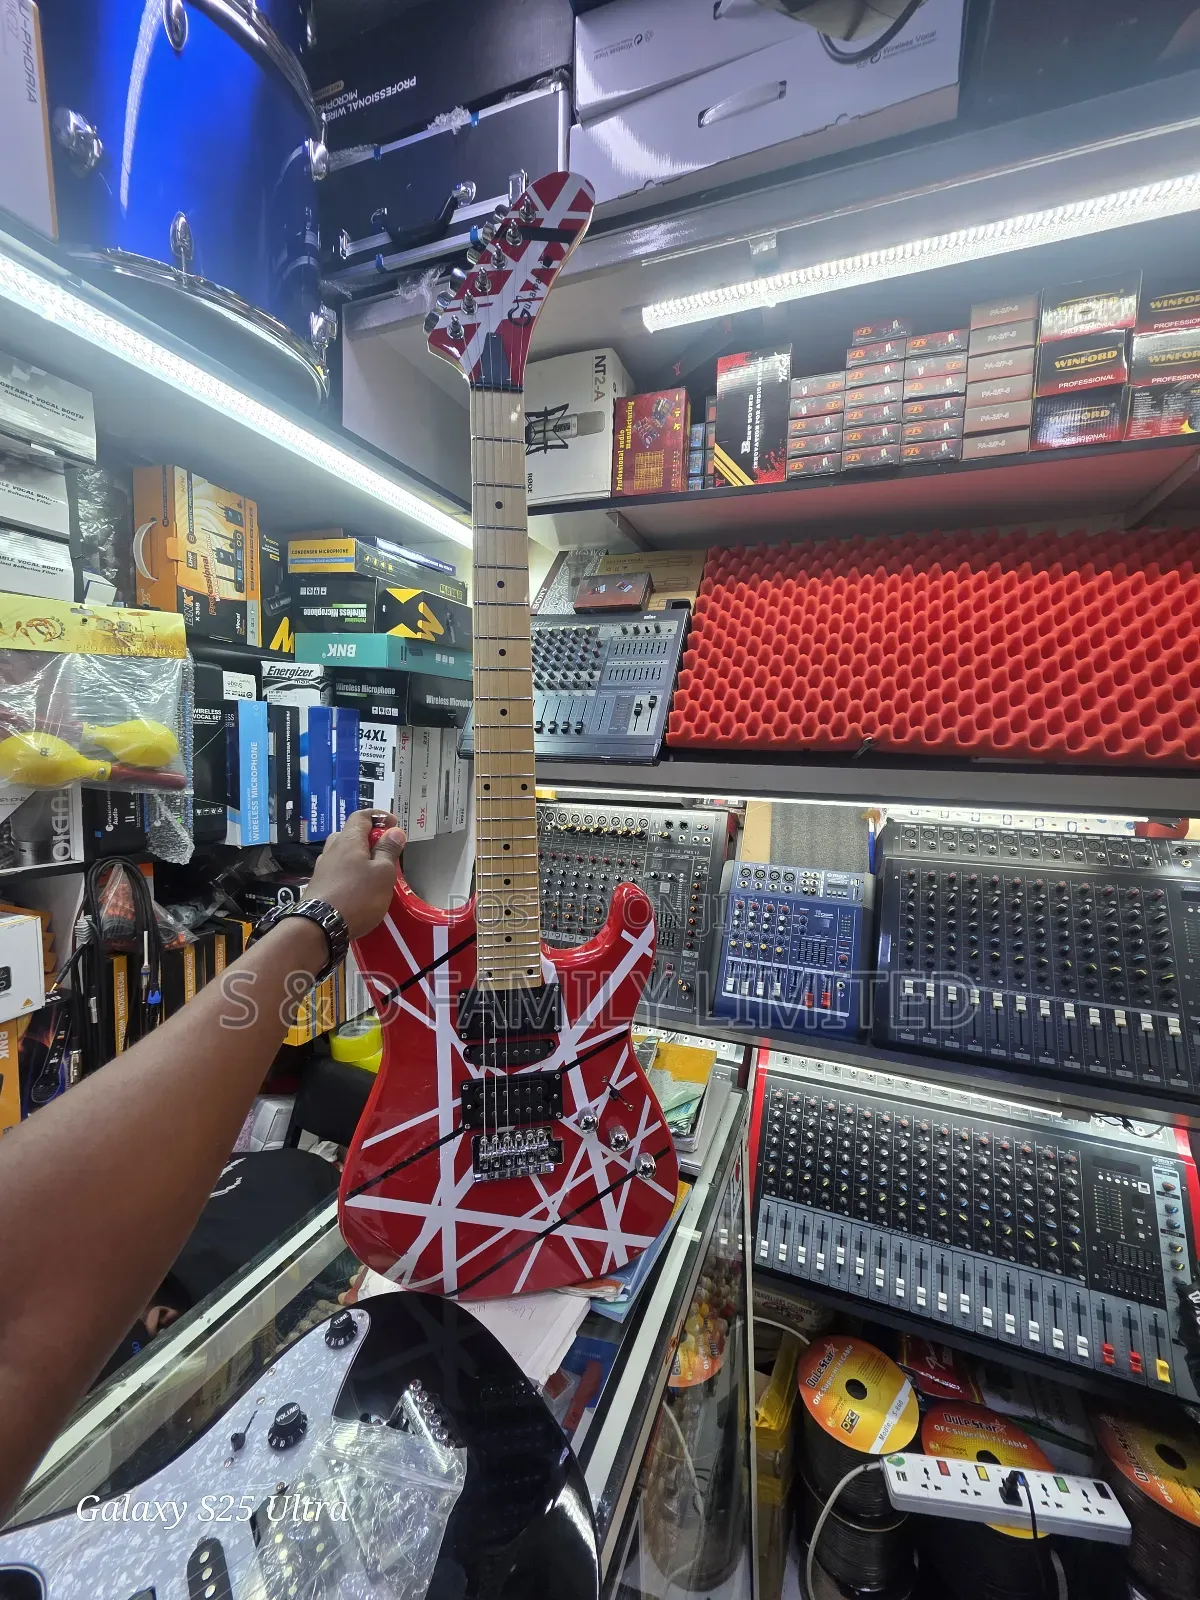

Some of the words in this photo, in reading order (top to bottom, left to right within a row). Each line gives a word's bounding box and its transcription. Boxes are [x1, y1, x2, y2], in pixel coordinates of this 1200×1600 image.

[349, 76, 416, 112] PROFESSIONAL
[1054, 349, 1118, 370] WINFORD
[594, 355, 607, 402] NT2-A
[1058, 373, 1116, 390] PROFESSIONAL
[1052, 431, 1109, 445] PROFESSIONAL
[616, 449, 624, 491] Professional
[16, 559, 40, 569] VOCAL
[41, 563, 65, 573] BOOTH
[532, 586, 548, 610] SONY
[184, 594, 194, 626] BNK
[303, 607, 339, 618] Microphone
[339, 607, 367, 618] Wireless
[327, 643, 357, 658] BNK
[266, 665, 313, 678] Energizer
[336, 682, 361, 693] Wireless
[361, 684, 396, 695] Microphone
[425, 694, 449, 706] Wireless
[401, 732, 410, 751] dbx
[251, 801, 260, 841] WIRELESS
[416, 807, 426, 828] dbx
[117, 971, 125, 1016] PROFESSIONAL
[333, 1313, 349, 1325] TONE
[812, 1390, 824, 1405] OFC
[275, 1404, 300, 1422] VOLUME
[841, 1408, 858, 1430] OFC
[933, 1423, 952, 1433] OFC
